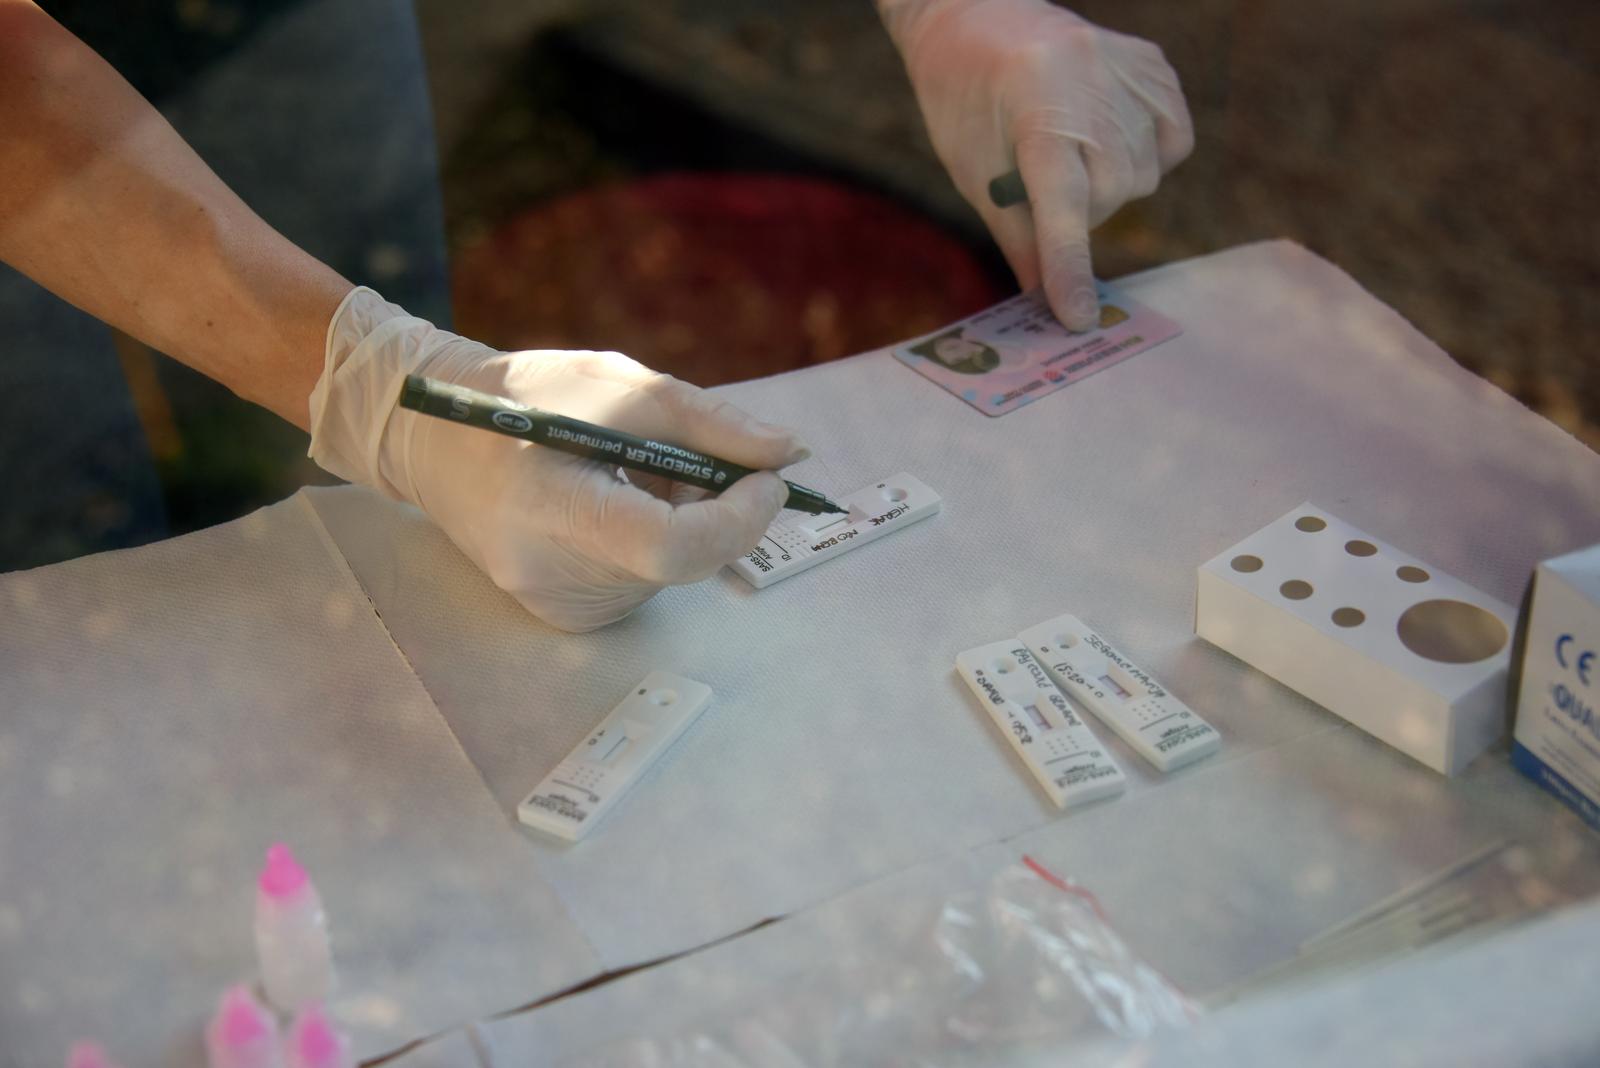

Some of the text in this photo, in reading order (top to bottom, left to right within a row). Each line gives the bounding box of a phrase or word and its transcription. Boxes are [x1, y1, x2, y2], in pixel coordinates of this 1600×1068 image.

[547, 426, 713, 481] STAEDTLER permanent
[755, 545, 773, 560] Antige
[781, 553, 793, 562] ID
[745, 552, 772, 573] SARS-C
